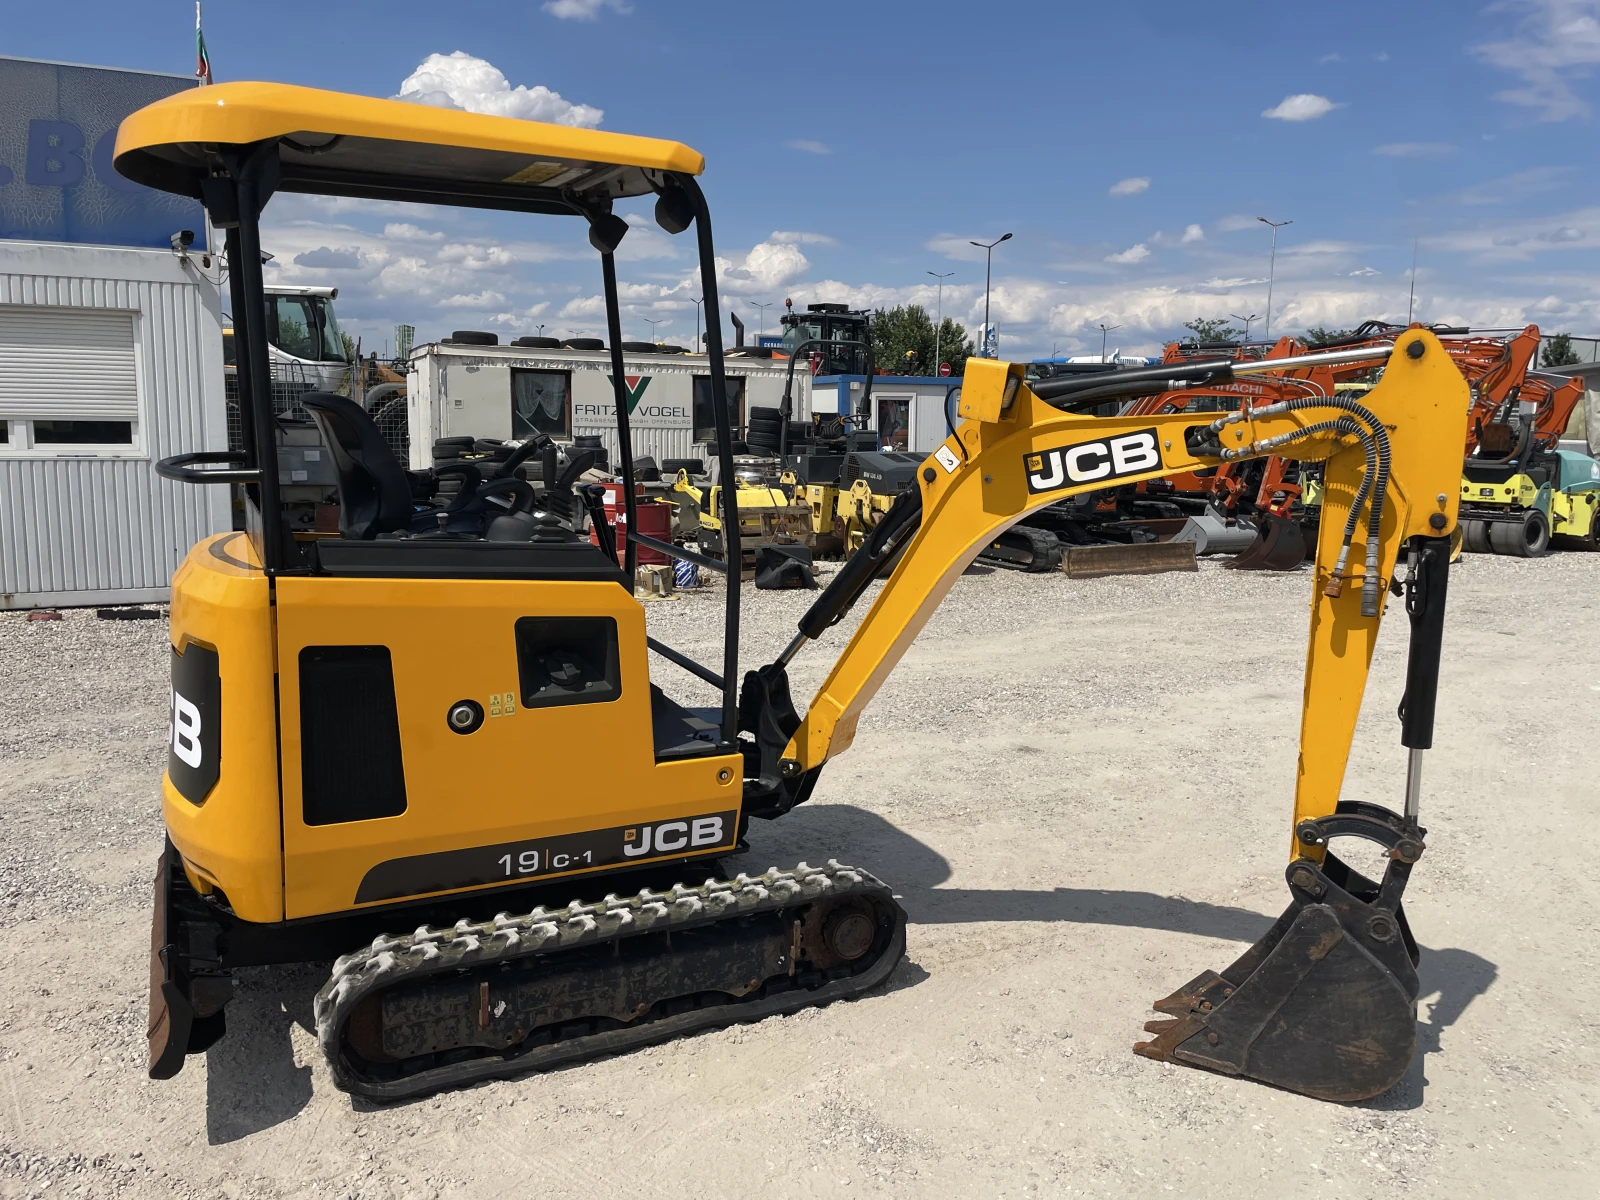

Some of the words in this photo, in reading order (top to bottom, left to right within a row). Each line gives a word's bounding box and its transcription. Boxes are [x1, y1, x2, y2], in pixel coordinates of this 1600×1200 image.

[575, 404, 618, 416] FRITZ
[638, 406, 691, 418] VOGEL
[1030, 433, 1159, 490] JCB
[624, 816, 724, 857] JCB
[498, 850, 539, 876] 19
